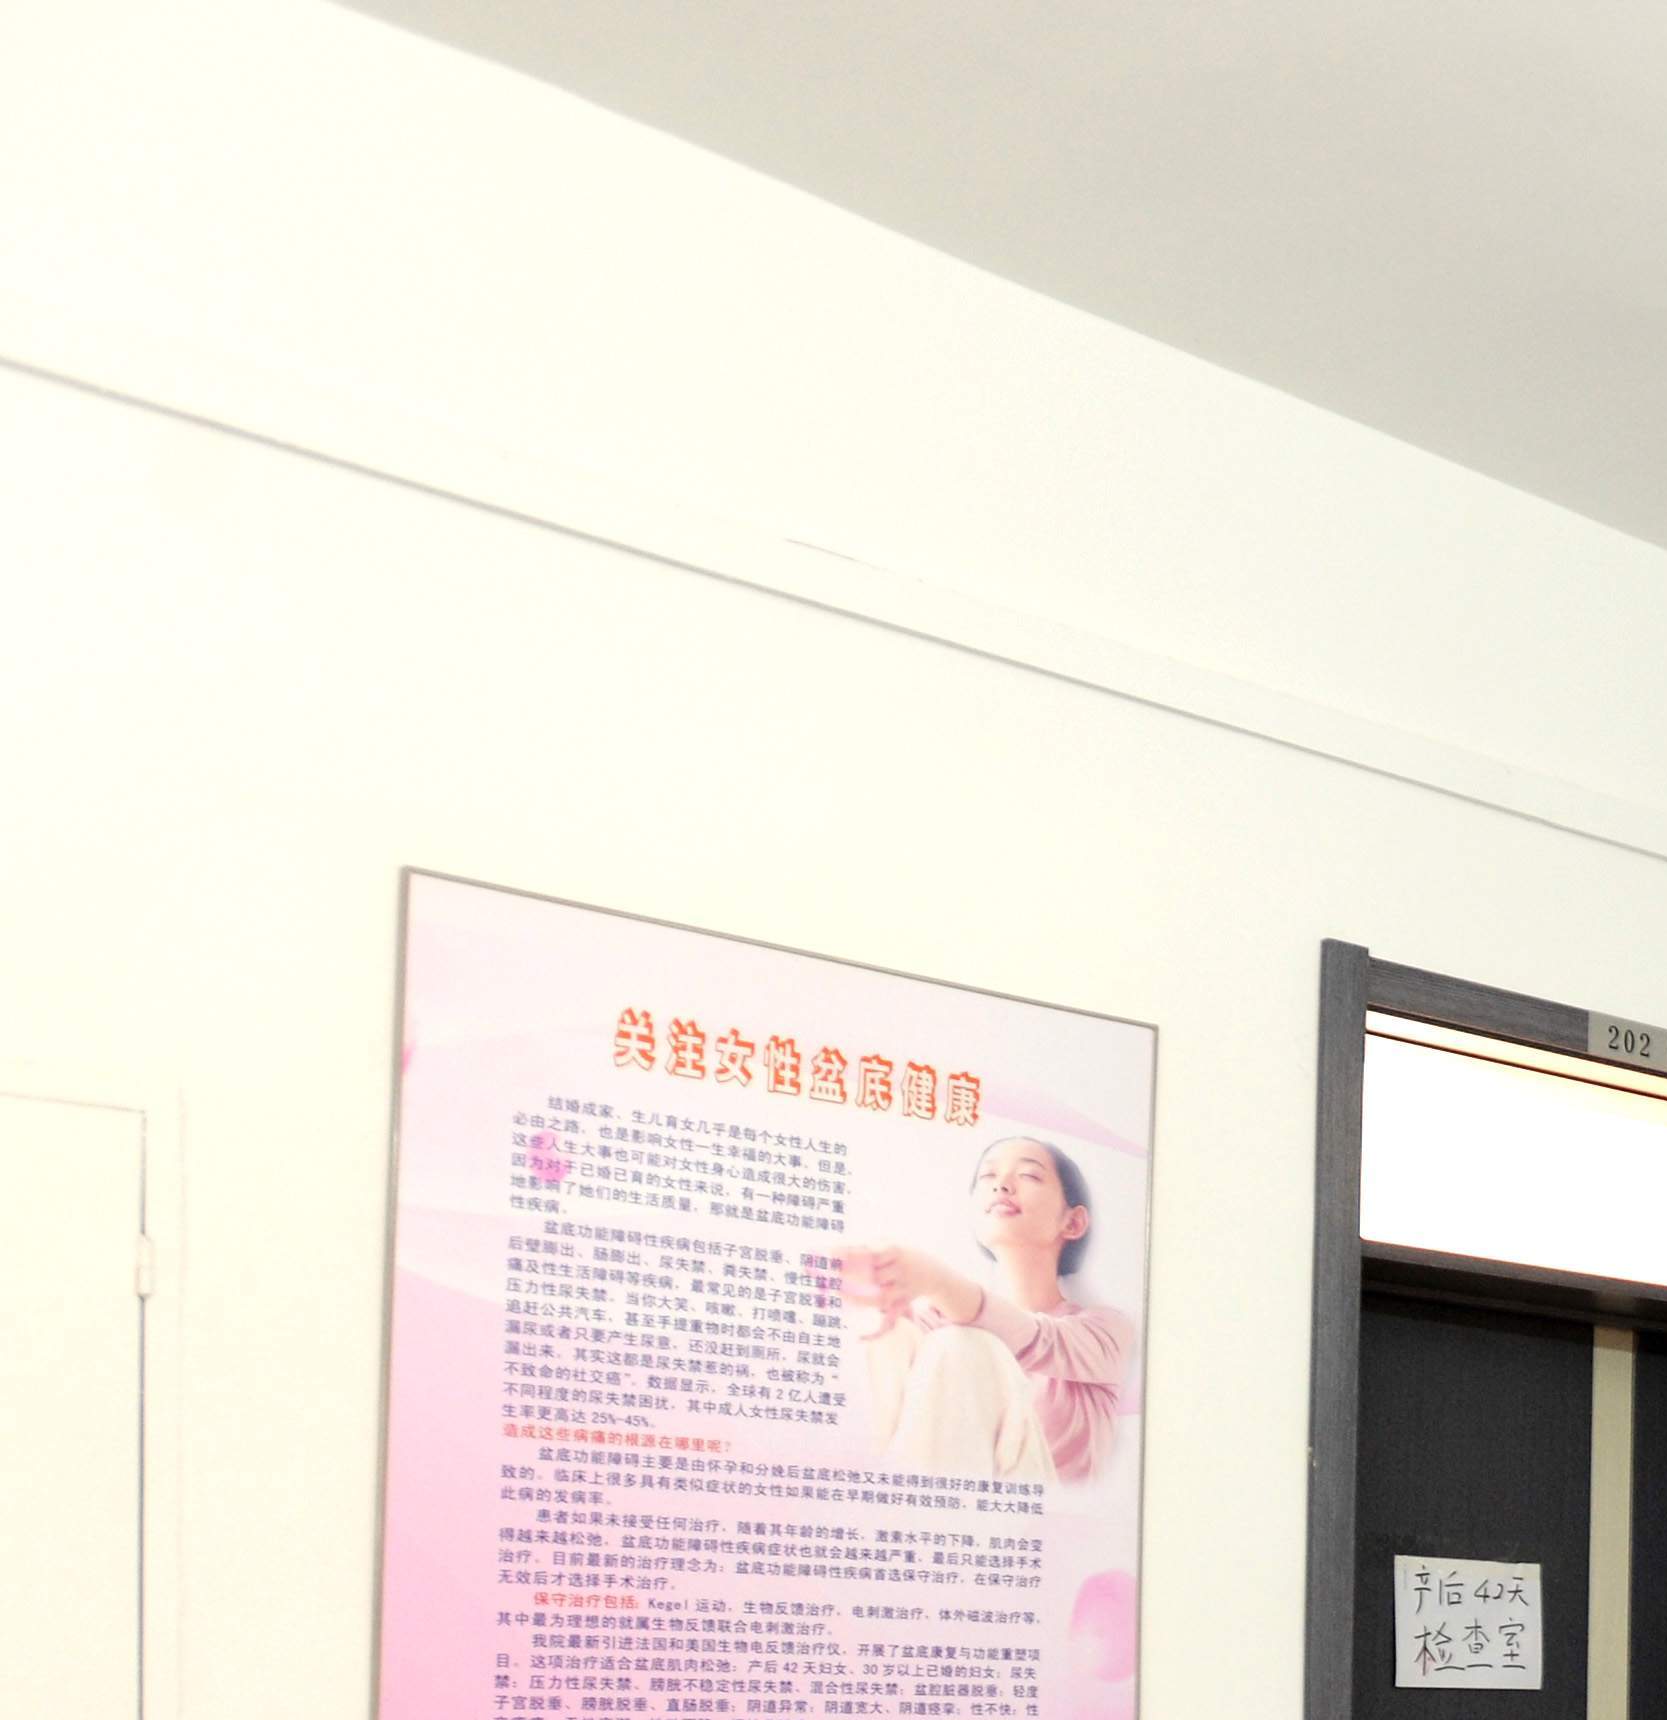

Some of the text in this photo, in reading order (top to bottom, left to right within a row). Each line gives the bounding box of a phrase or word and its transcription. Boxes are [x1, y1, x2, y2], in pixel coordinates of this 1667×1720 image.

[613, 1007, 982, 1127] 关注女性盆底健康
[1608, 1025, 1650, 1057] 202
[1413, 1618, 1527, 1677] 检查室
